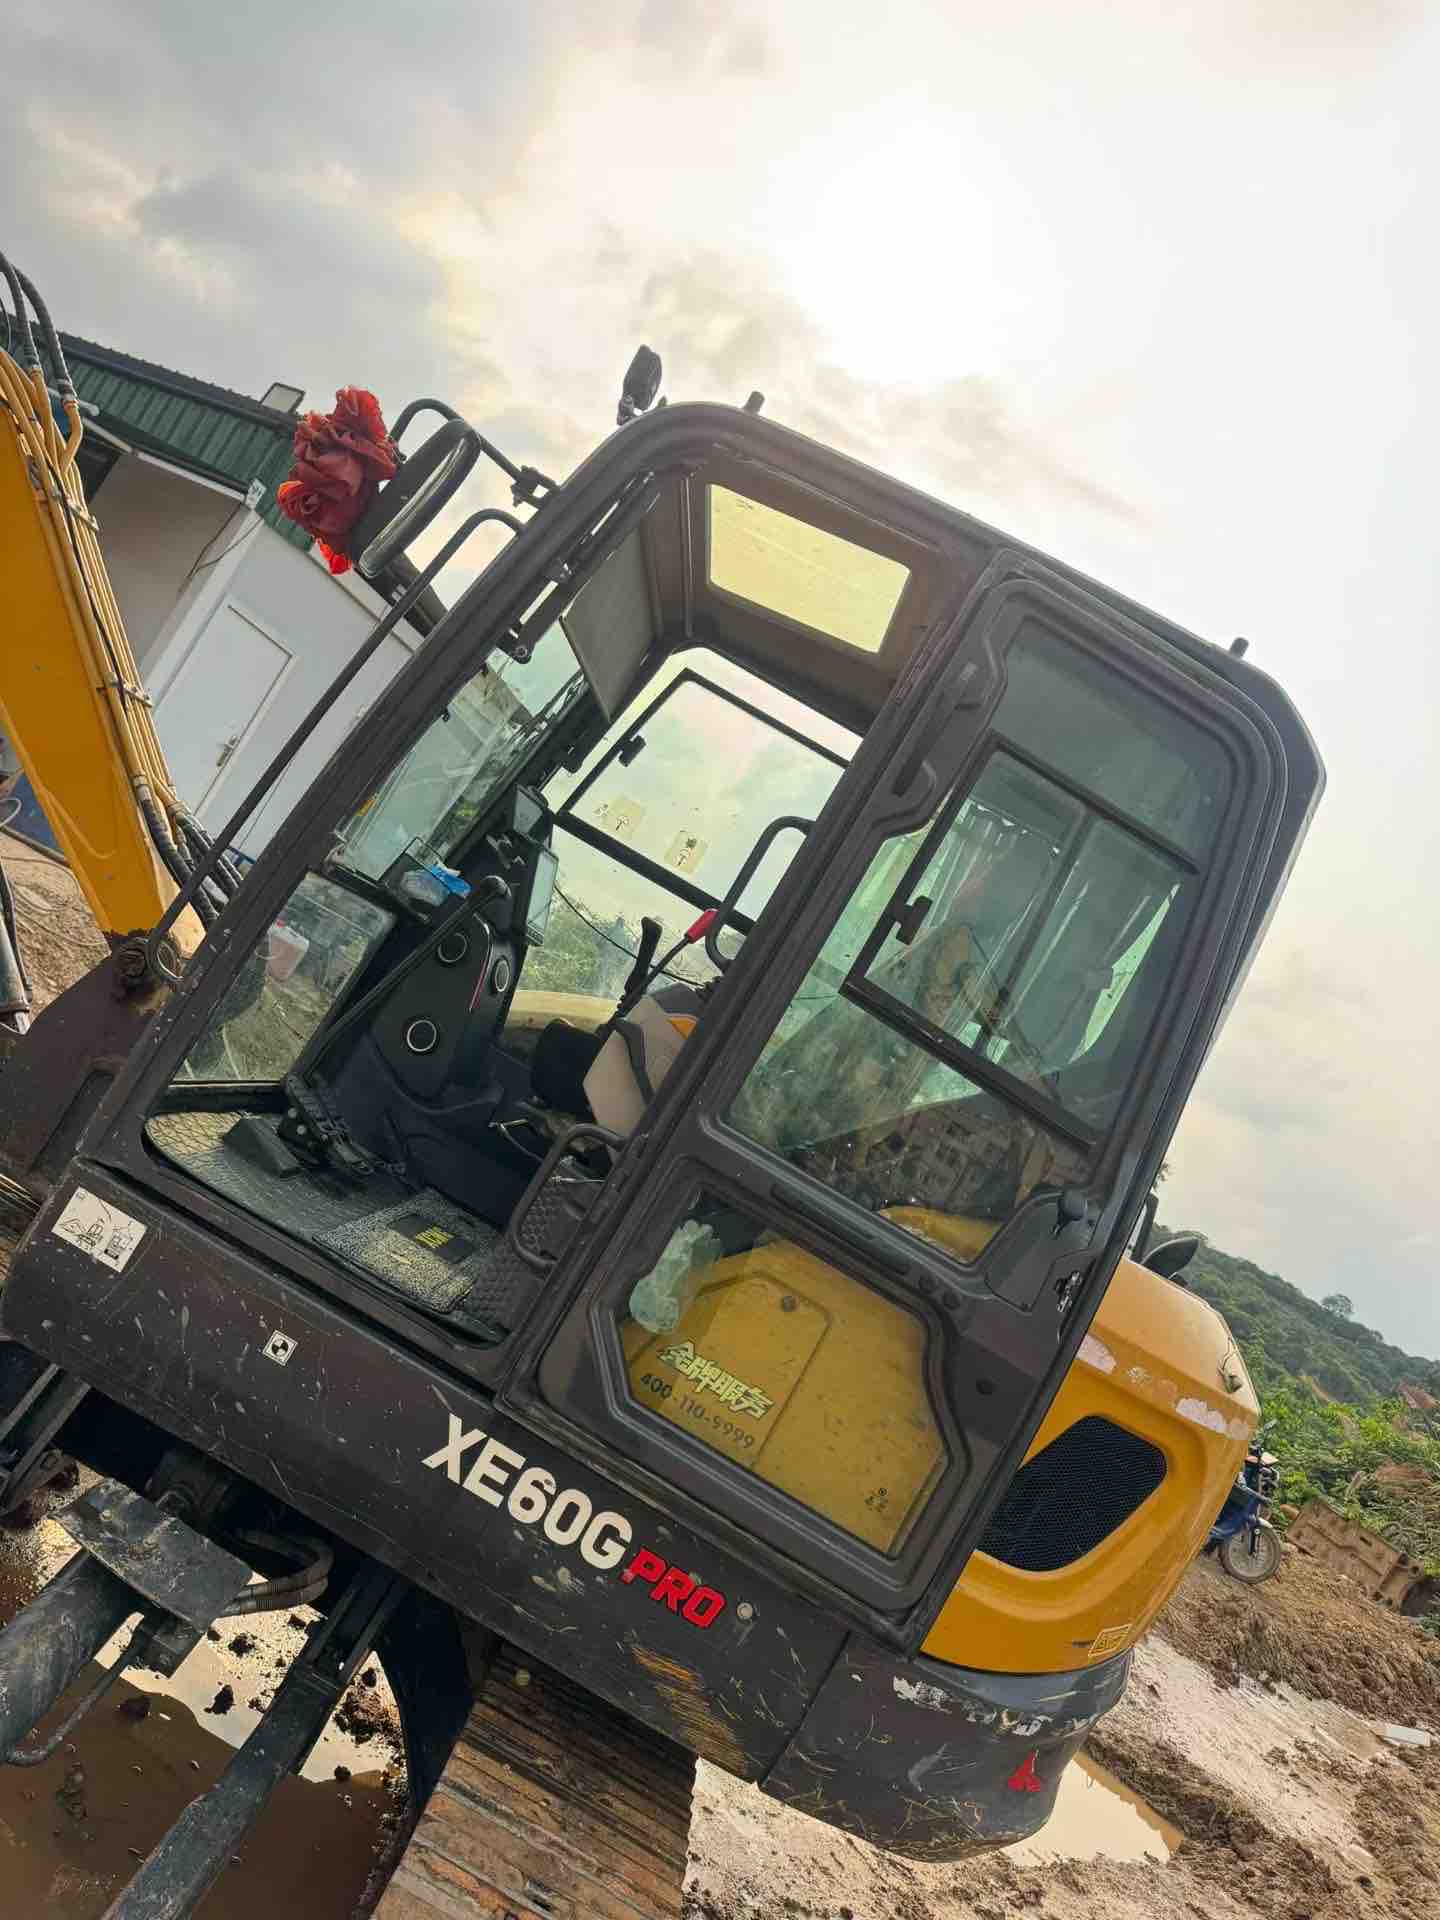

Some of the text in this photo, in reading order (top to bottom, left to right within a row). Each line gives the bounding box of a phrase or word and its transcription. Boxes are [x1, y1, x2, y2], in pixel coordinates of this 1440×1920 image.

[657, 1338, 775, 1420] 金牌服务
[421, 1412, 727, 1629] XE60G PRO
